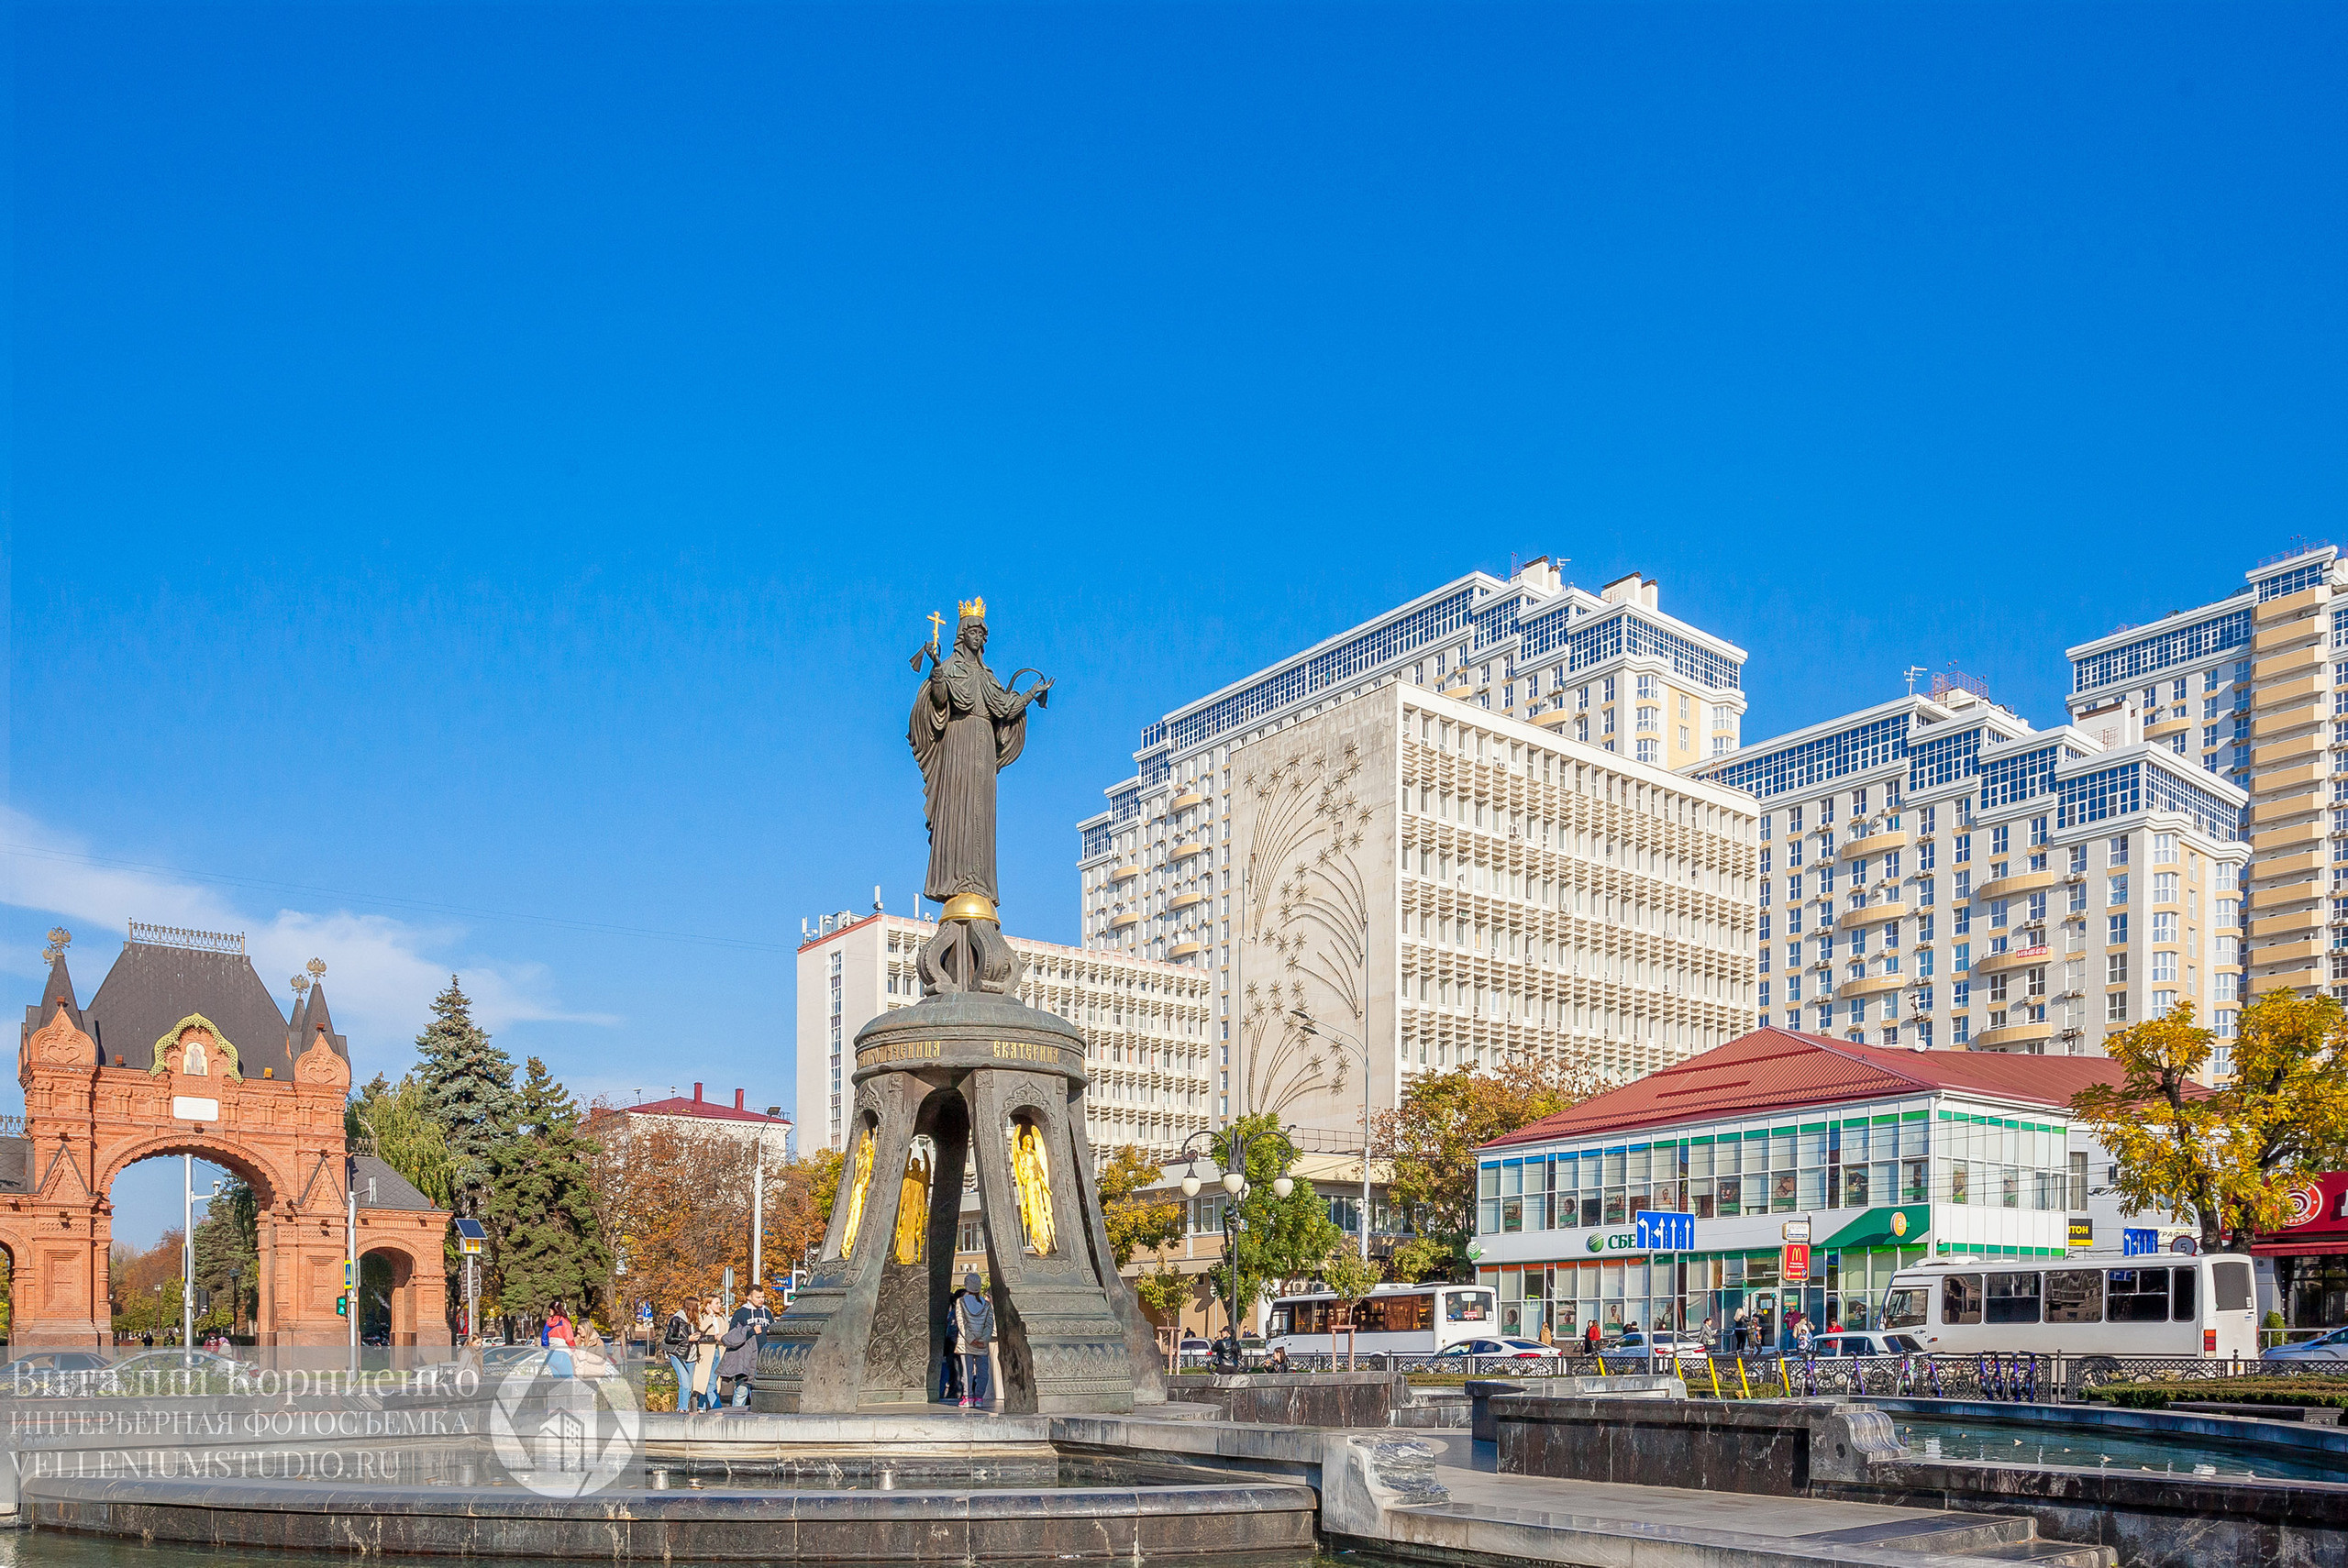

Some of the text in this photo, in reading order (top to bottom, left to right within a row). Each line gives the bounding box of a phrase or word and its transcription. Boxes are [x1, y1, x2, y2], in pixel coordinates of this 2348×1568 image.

[993, 1040, 1059, 1065] ЕКАТЕРИНА
[2180, 1242, 2187, 1253] 5
[645, 1309, 652, 1317] P
